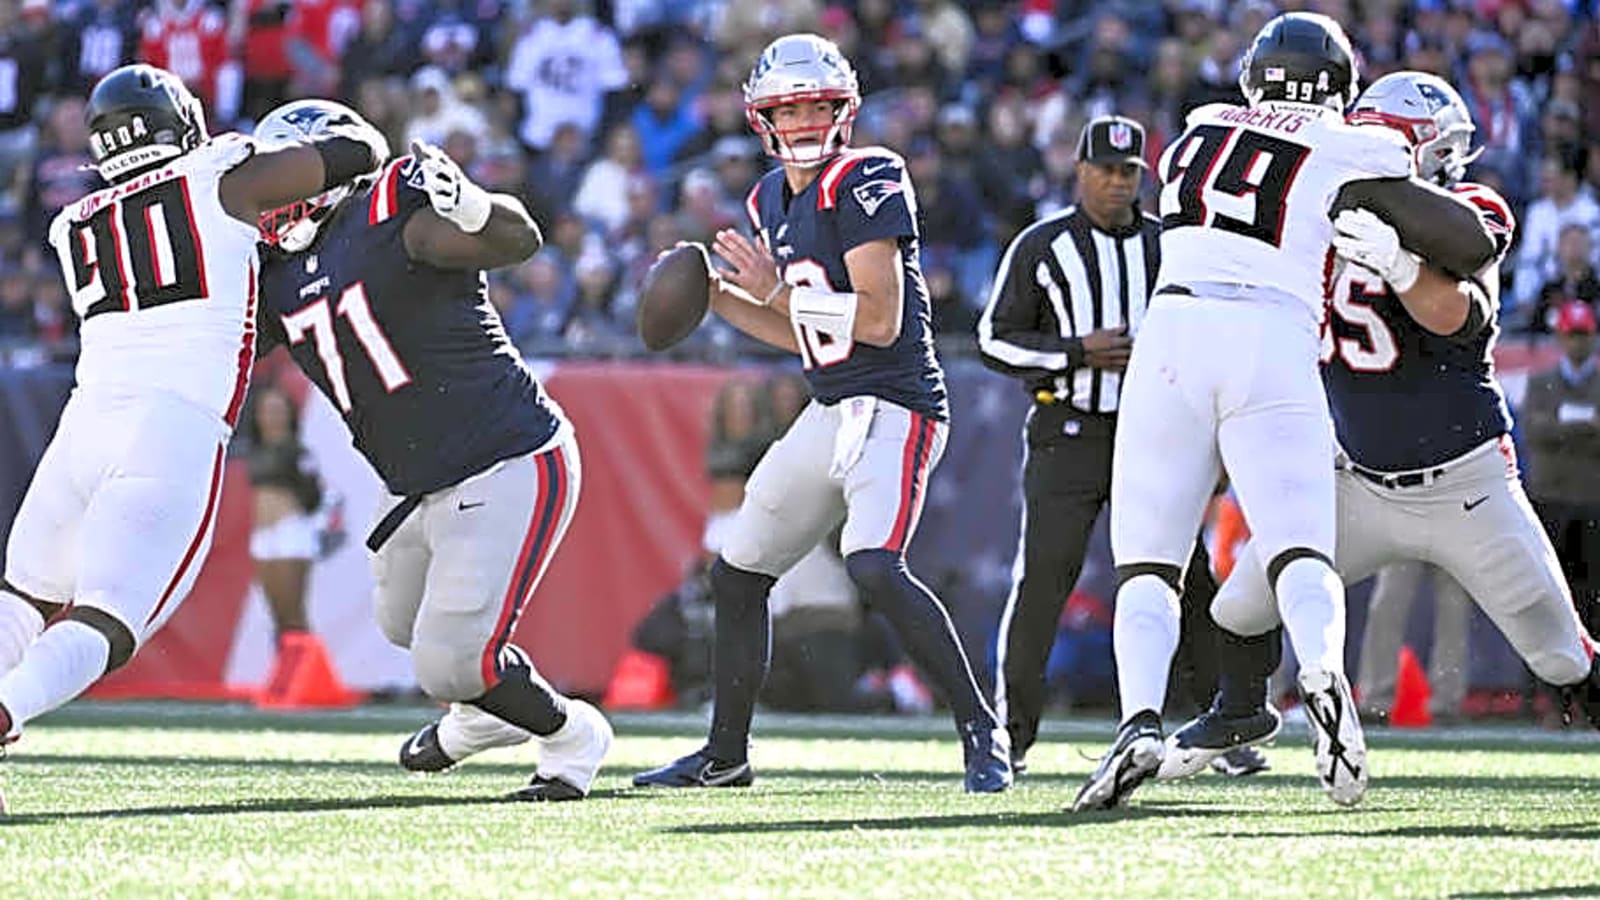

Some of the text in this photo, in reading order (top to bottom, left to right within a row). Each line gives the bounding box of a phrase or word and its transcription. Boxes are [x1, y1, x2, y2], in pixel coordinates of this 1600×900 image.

[1285, 81, 1314, 101] 99
[68, 174, 209, 320] 90
[1163, 124, 1312, 249] 99
[281, 281, 413, 414] 71
[1320, 259, 1401, 372] 5
